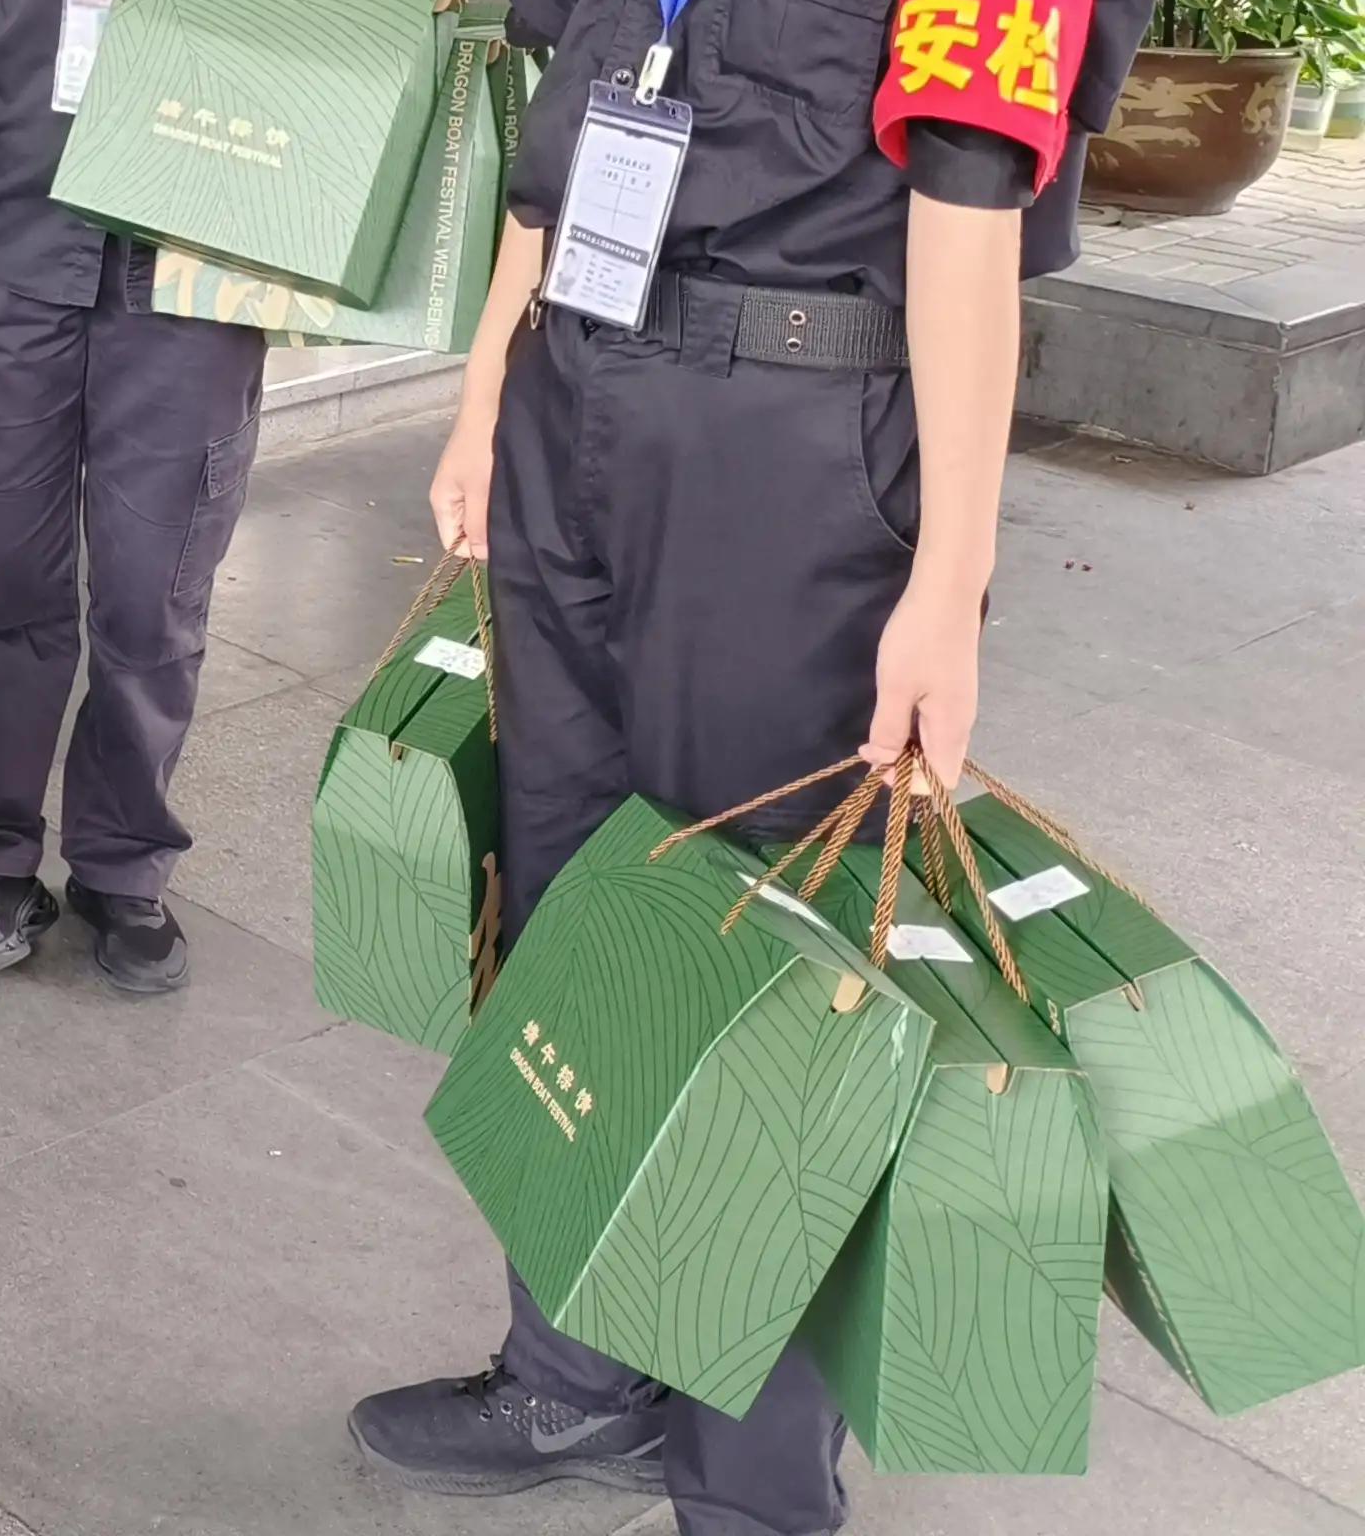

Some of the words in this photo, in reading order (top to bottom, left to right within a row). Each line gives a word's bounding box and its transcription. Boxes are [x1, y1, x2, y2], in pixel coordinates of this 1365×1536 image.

[453, 40, 476, 113] DRAGON
[445, 116, 463, 165] BOAT
[435, 166, 457, 247] FESTIVAL
[547, 1097, 577, 1142] FESTIVAL
